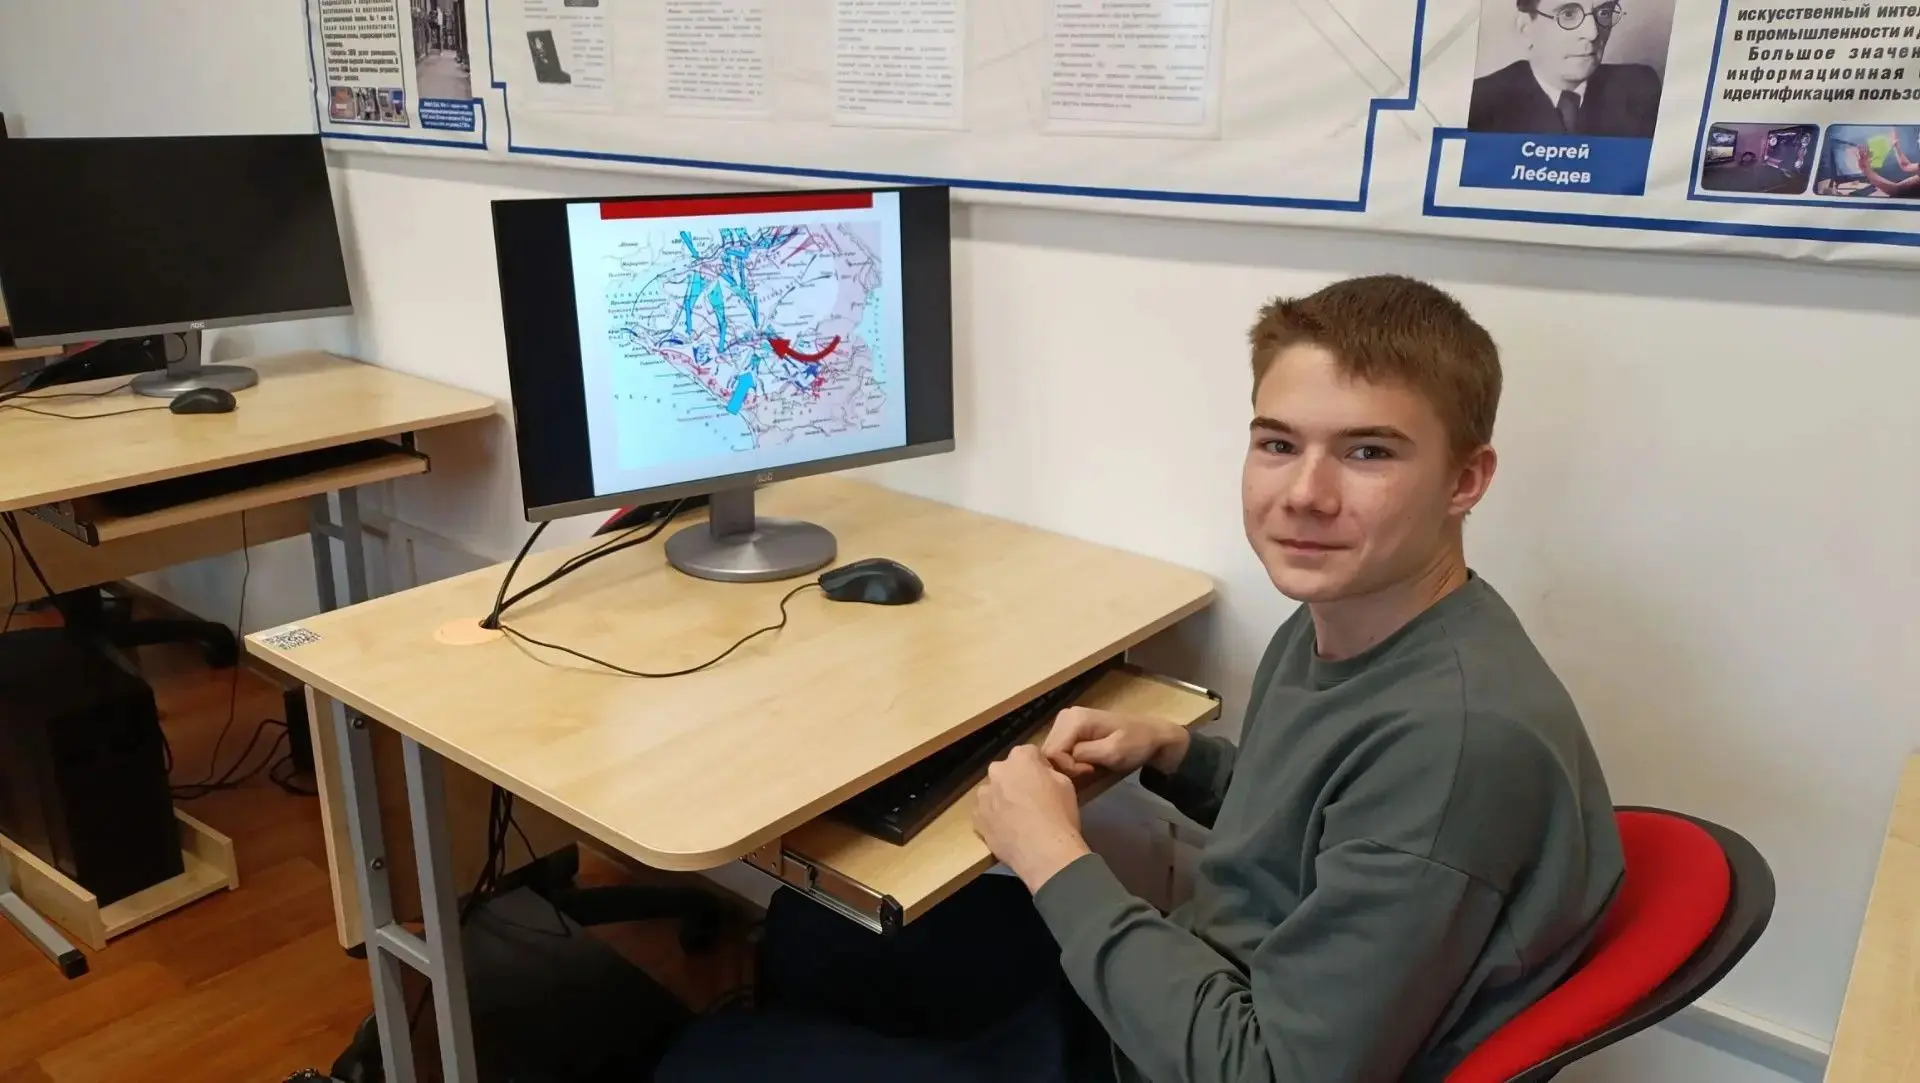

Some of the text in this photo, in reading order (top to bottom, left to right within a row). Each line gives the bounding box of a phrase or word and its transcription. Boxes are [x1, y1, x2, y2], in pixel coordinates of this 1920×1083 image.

[1737, 3, 1870, 23] искусственный
[1733, 29, 1743, 41] в
[1746, 26, 1900, 44] промышленности
[1903, 26, 1915, 38] и
[1748, 46, 1836, 61] Большое
[1726, 66, 1905, 83] информационная
[1722, 86, 1855, 103] идентификация
[1521, 141, 1590, 161] Сергей
[1511, 164, 1592, 185] Лебедев
